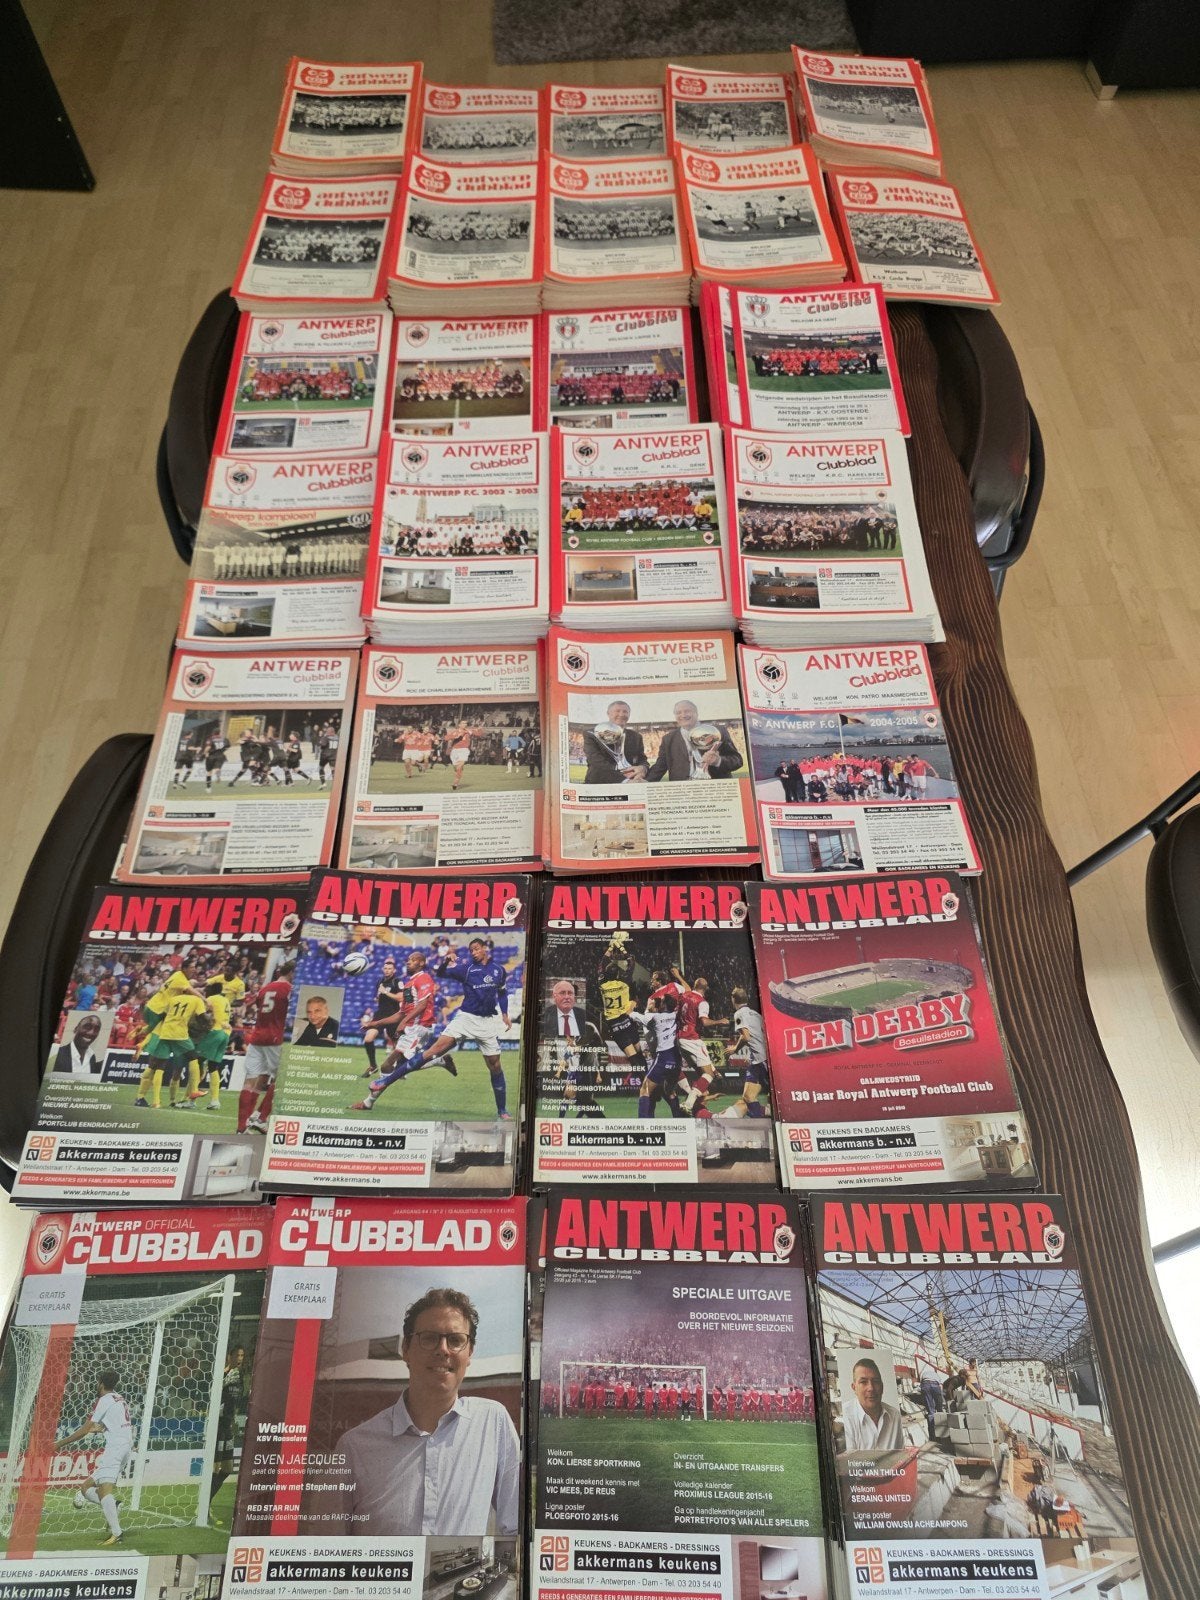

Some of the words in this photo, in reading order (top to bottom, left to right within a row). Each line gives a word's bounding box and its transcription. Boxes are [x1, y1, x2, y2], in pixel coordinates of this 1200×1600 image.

[779, 291, 871, 304] ANTWERP
[807, 297, 872, 315] Clubblad
[589, 310, 678, 323] ANTWERP
[298, 318, 377, 330] ANTWERP
[441, 321, 529, 332] ANTWERP
[615, 315, 678, 333] Clubblad
[320, 326, 376, 340] Clubblad
[465, 326, 528, 342] Clubblad
[613, 434, 703, 450] ANTWERP
[442, 443, 533, 458] ANTWERP
[641, 447, 701, 463] Clubblad
[786, 444, 879, 458] ANTWERP
[470, 456, 529, 471] Clubblad
[816, 456, 877, 471] Clubblad
[273, 462, 373, 479] ANTWERP
[307, 473, 373, 493] Clubblad
[412, 488, 461, 497] ANTWERP
[623, 641, 716, 656] ANTWERP
[249, 660, 342, 672] ANTWERP
[437, 654, 529, 667] ANTWERP
[671, 653, 718, 666] Clubblad
[805, 649, 918, 671] ANTWERP
[293, 672, 342, 684] Clubblad
[482, 665, 529, 678] Clubblad
[849, 664, 922, 688] Clubblad
[765, 719, 816, 730] ANTWERP
[870, 716, 919, 727] 2004-2005
[313, 876, 517, 919] ANTWERP
[548, 885, 742, 921] ANTWERP
[759, 877, 952, 924] ANTWERP
[92, 895, 297, 934] ANTWERP
[311, 911, 516, 927] CLUBBLAD
[547, 919, 744, 929] CLUBBLAD
[760, 913, 958, 932] CLUBBLAD
[88, 930, 291, 942] CLUBBLAD
[261, 991, 277, 1013] 5
[605, 992, 623, 1009] 21
[172, 1002, 188, 1017] 11
[784, 1019, 847, 1055] DEN
[853, 995, 968, 1042] DERBY
[898, 1028, 963, 1048] Bosuilstadion
[860, 1074, 921, 1085] GALAWEDSTRIJD
[283, 1088, 313, 1096] RICHARD
[790, 1090, 810, 1102] 130
[812, 1091, 834, 1103] jaar
[836, 1088, 869, 1102] Royal
[871, 1085, 919, 1099] Antwerp
[921, 1083, 966, 1095] Football
[967, 1081, 994, 1092] Club
[70, 1102, 112, 1110] AANWINSTEN
[281, 1106, 320, 1114] LUCHTFOTO
[37, 1120, 78, 1128] SPORTCLUB
[78, 1121, 119, 1129] EENDRACHT
[305, 1136, 363, 1147] akkermans
[58, 1151, 125, 1160] akkermans
[129, 1151, 178, 1161] keukens
[313, 1175, 381, 1184] www.akkermans.be
[291, 1208, 352, 1218] ANTWERP
[72, 1220, 142, 1233] ANTWERP
[144, 1218, 196, 1230] OFFICIAL
[554, 1197, 788, 1252] ANTWERP
[64, 1229, 263, 1265] CLUBBLAD
[553, 1246, 790, 1264] CLUBBLAD
[39, 1291, 66, 1299] GRATIS
[672, 1287, 734, 1300] SPECIALE
[737, 1289, 792, 1301] UITGAVE
[28, 1303, 71, 1312] EXEMPLAAR
[689, 1311, 743, 1321] BOORDEVOL
[743, 1313, 794, 1323] INFORMATIE
[677, 1321, 701, 1330] OVER
[702, 1322, 719, 1331] HET
[721, 1322, 754, 1331] NIEUWE
[258, 1422, 307, 1434] Welkom
[253, 1454, 285, 1465] SVEN
[286, 1454, 346, 1466] JAECQUES
[547, 1458, 565, 1466] KON.
[593, 1459, 641, 1468] SPORTKRING
[697, 1462, 740, 1471] UITGAANDE
[741, 1463, 785, 1472] TRANSFERS
[848, 1469, 863, 1477] LUC
[863, 1469, 880, 1477] VAN
[880, 1468, 906, 1477] THILLO
[250, 1483, 287, 1491] Interview
[288, 1483, 304, 1491] met
[305, 1483, 338, 1492] Stephen
[673, 1490, 713, 1499] PROXIMUS
[714, 1491, 745, 1500] LEAGUE
[746, 1492, 773, 1500] 2015-16
[851, 1495, 883, 1503] SERAING
[884, 1494, 911, 1502] UNITED
[545, 1512, 591, 1521] PLOEGFOTO
[592, 1513, 619, 1521] 2015-16
[853, 1520, 886, 1529] WILLIAM
[886, 1520, 914, 1529] OWUSU
[914, 1520, 968, 1529] ACHEAMPONG
[39, 1569, 88, 1577] BADKAMERS
[94, 1568, 139, 1576] DRESSINGS
[269, 1565, 346, 1578] akkermans
[351, 1565, 409, 1578] keukens
[76, 1584, 133, 1596] keukens
